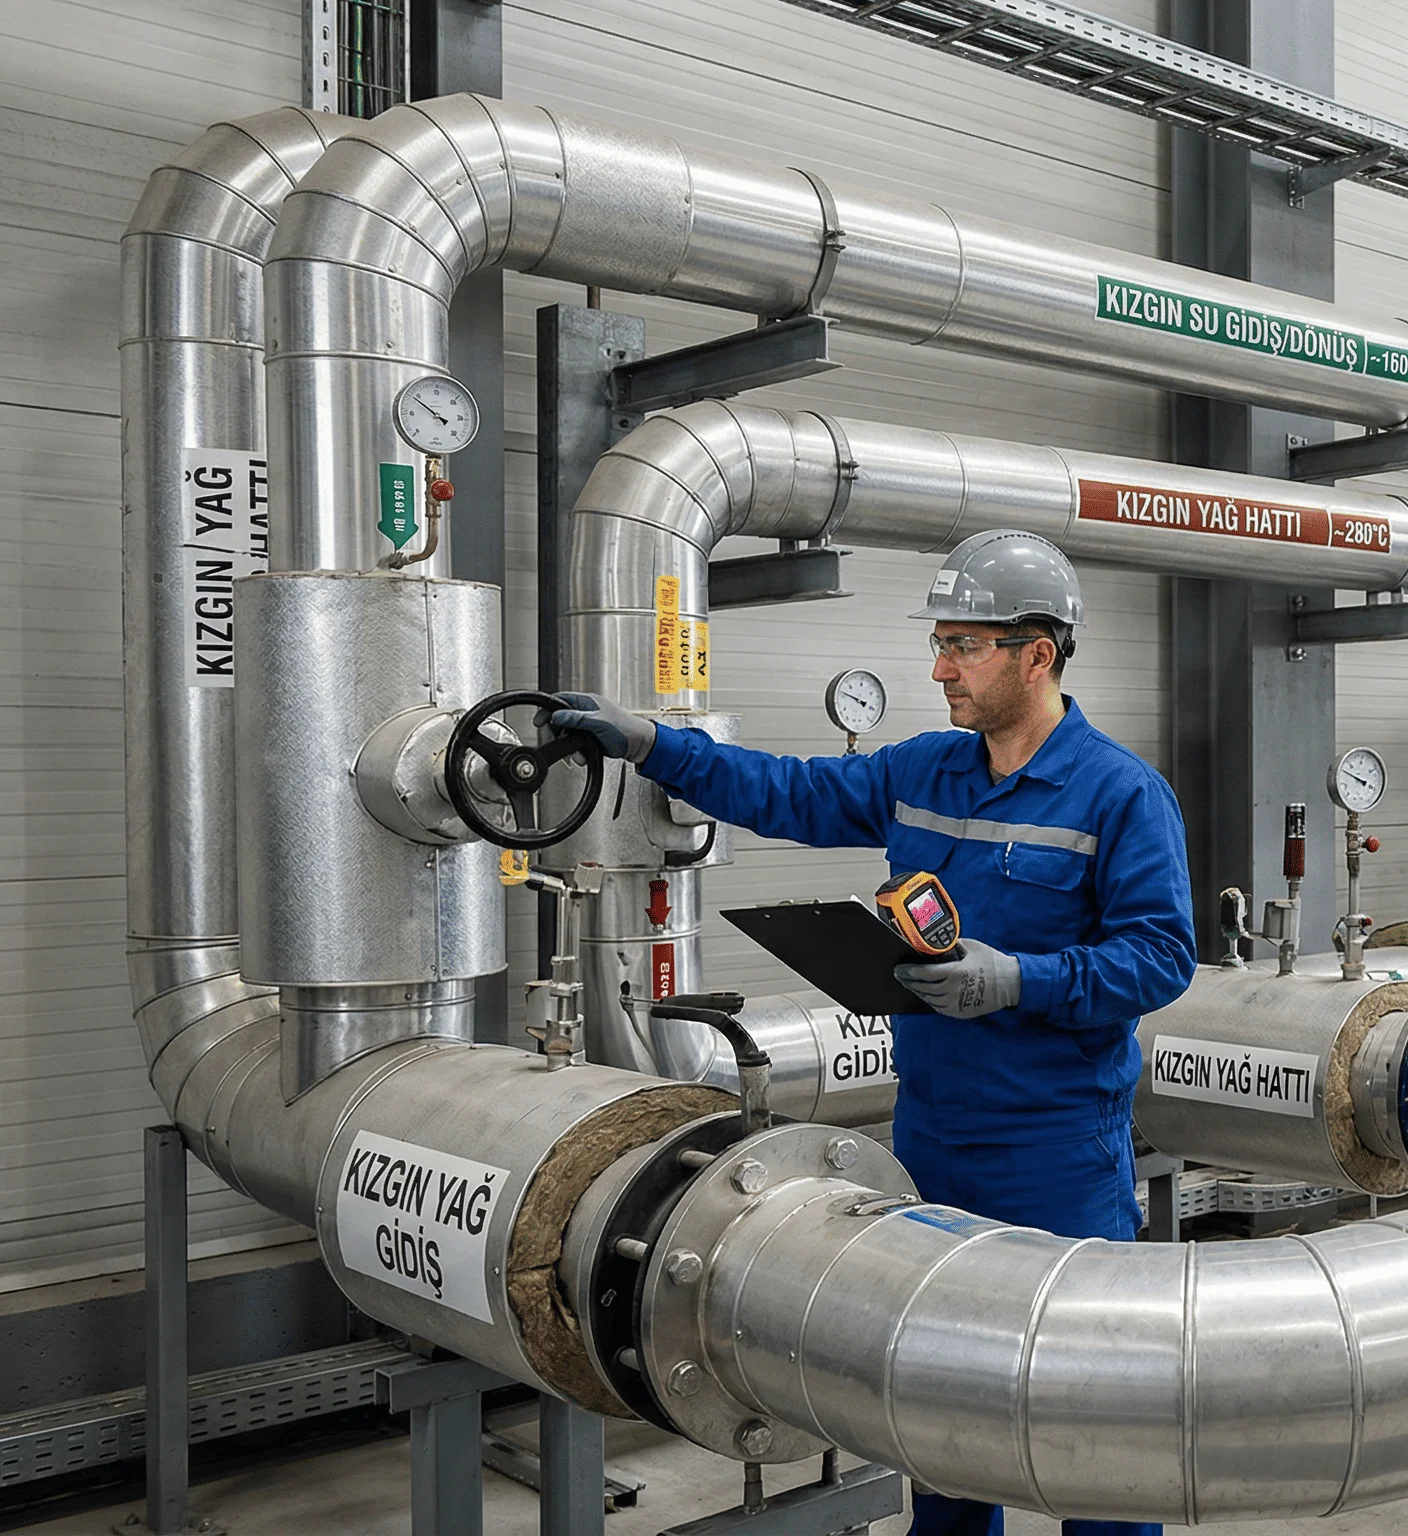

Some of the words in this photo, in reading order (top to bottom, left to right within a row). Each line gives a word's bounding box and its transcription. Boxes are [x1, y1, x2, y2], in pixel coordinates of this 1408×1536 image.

[1105, 283, 1183, 328] KIZGIN
[1189, 302, 1219, 335] SU
[1226, 309, 1358, 371] GİDİŞ/DÖNÜŞ
[185, 466, 233, 537] YAĞ
[1116, 489, 1191, 526] KIZGIN
[1196, 498, 1239, 531] YAĞ
[1245, 509, 1301, 538] HATTI
[195, 560, 234, 676] KIZGIN
[835, 1012, 891, 1039] KIZ
[1154, 1049, 1212, 1089] KIZGIN
[1216, 1053, 1252, 1095] YAĞ
[1256, 1063, 1310, 1104] HATTI
[343, 1147, 433, 1217] KIZGIN
[434, 1172, 496, 1236] YAĞ
[376, 1217, 443, 1300] GİDİŞ
